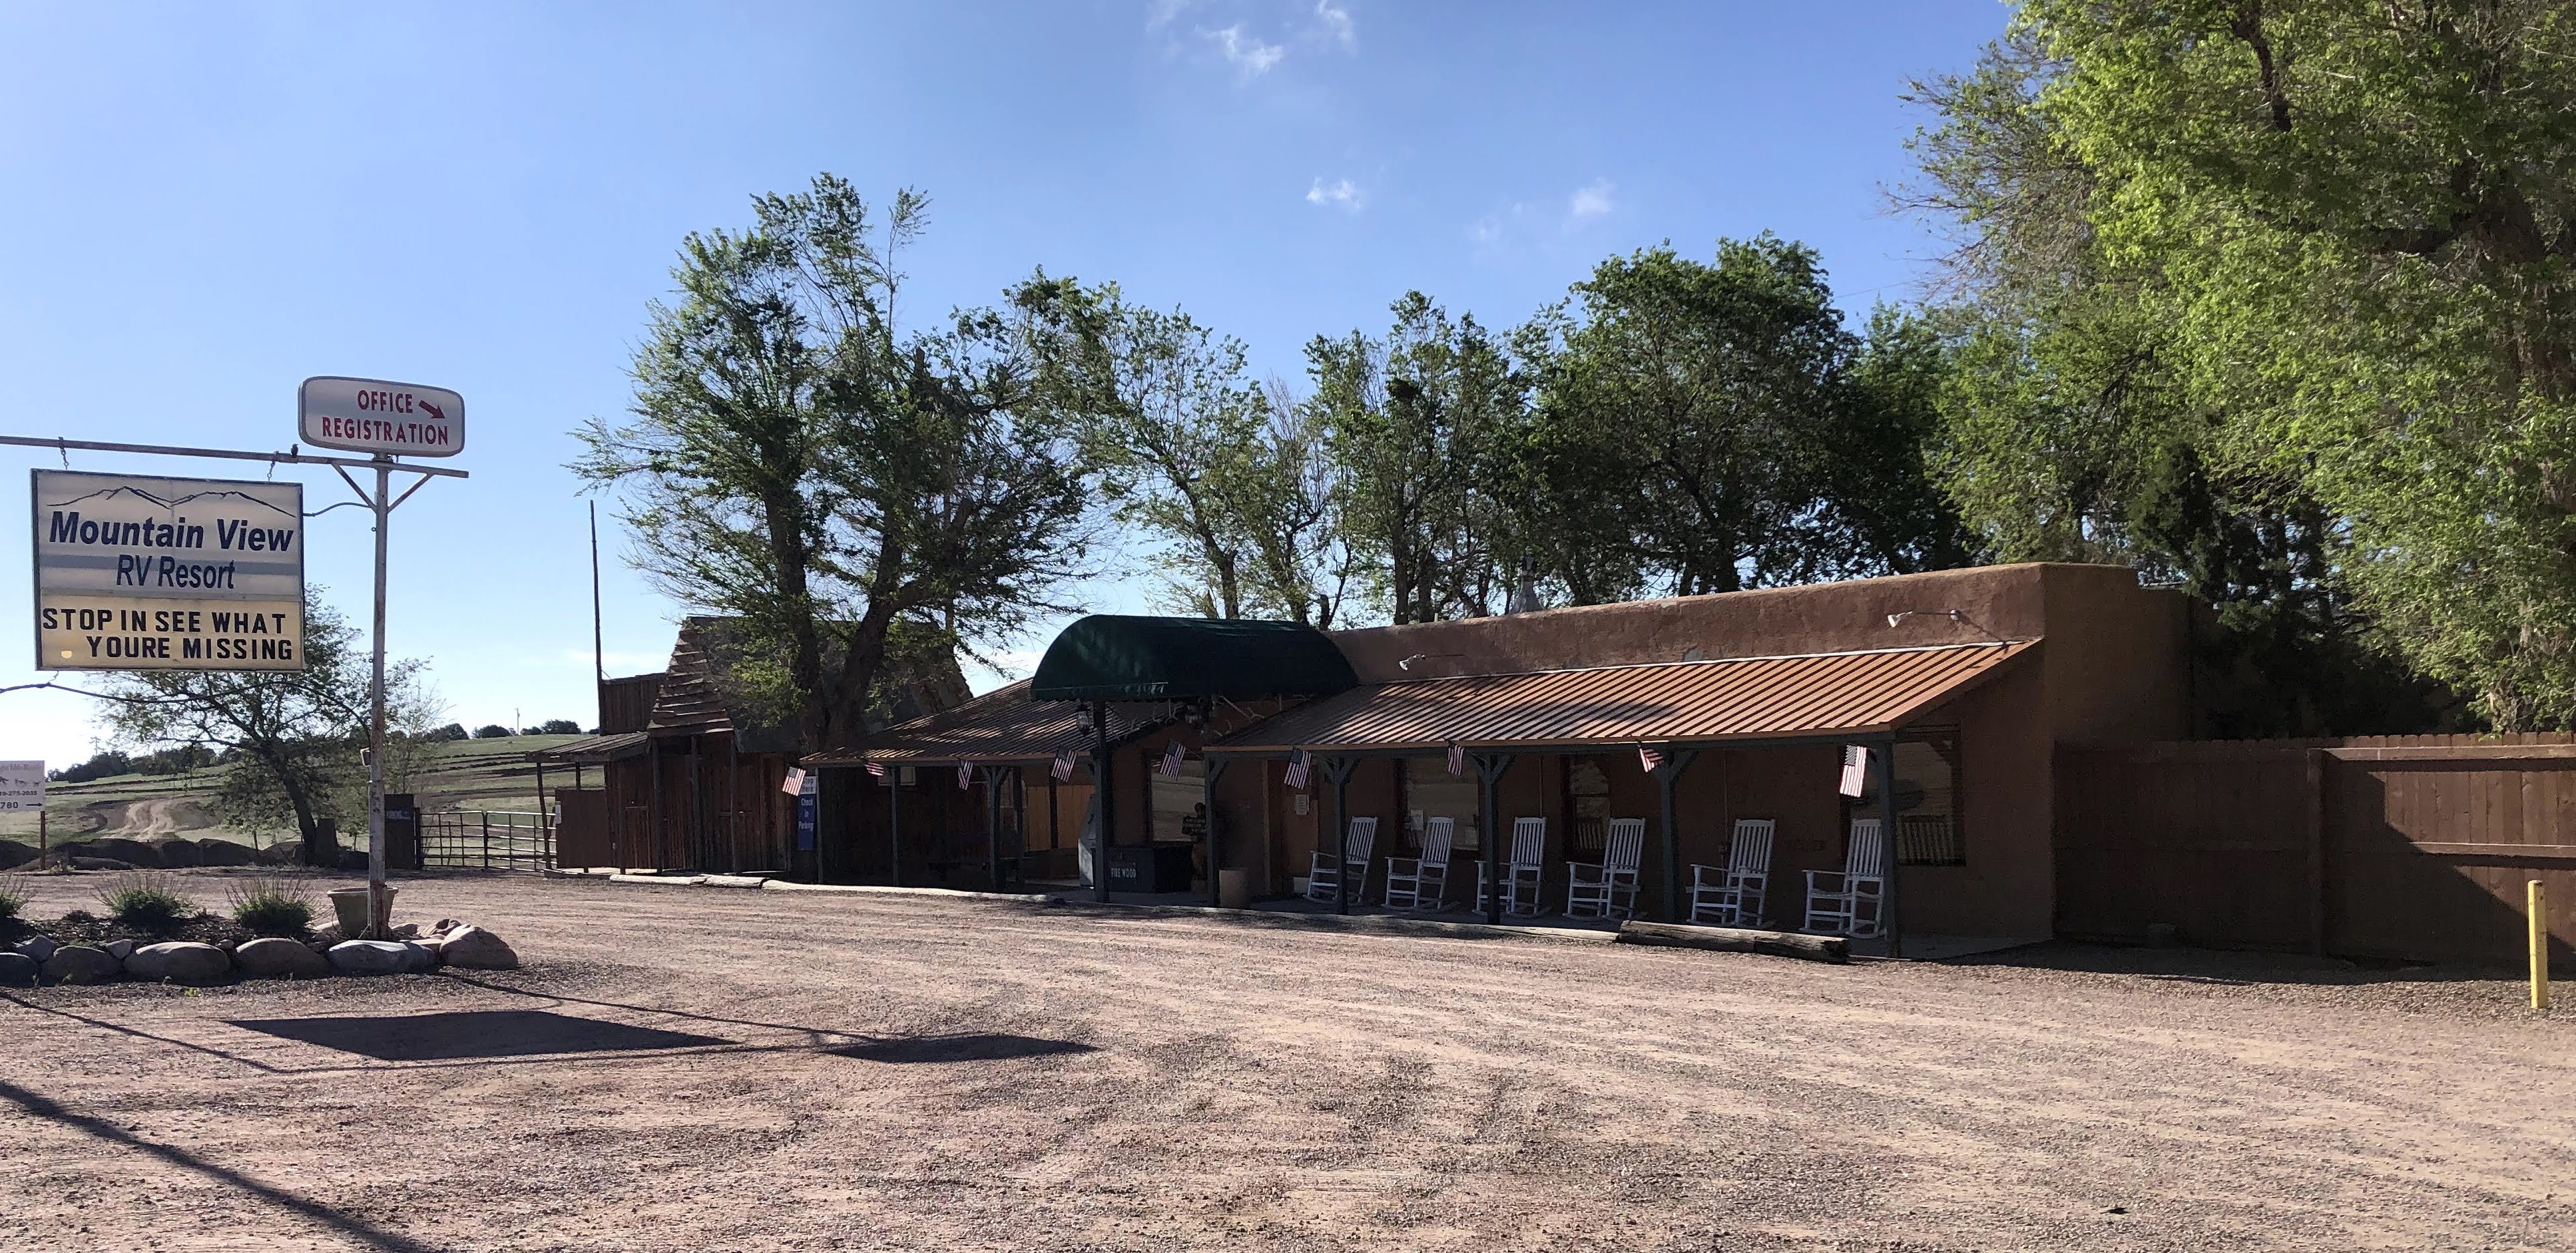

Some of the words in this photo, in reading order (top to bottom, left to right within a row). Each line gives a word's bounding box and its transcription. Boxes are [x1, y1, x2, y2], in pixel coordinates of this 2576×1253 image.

[358, 389, 413, 413] OFFICE
[322, 416, 449, 446] REGISTRATION
[49, 511, 204, 549] Mountain
[216, 518, 294, 552] View
[116, 554, 152, 587] RV
[157, 555, 236, 589] Resort
[43, 608, 113, 631] STOP
[121, 609, 146, 632] IN
[154, 611, 201, 633] SEE
[211, 611, 286, 634] WHAT
[86, 635, 170, 659] YOURE
[182, 637, 292, 660] MISSING
